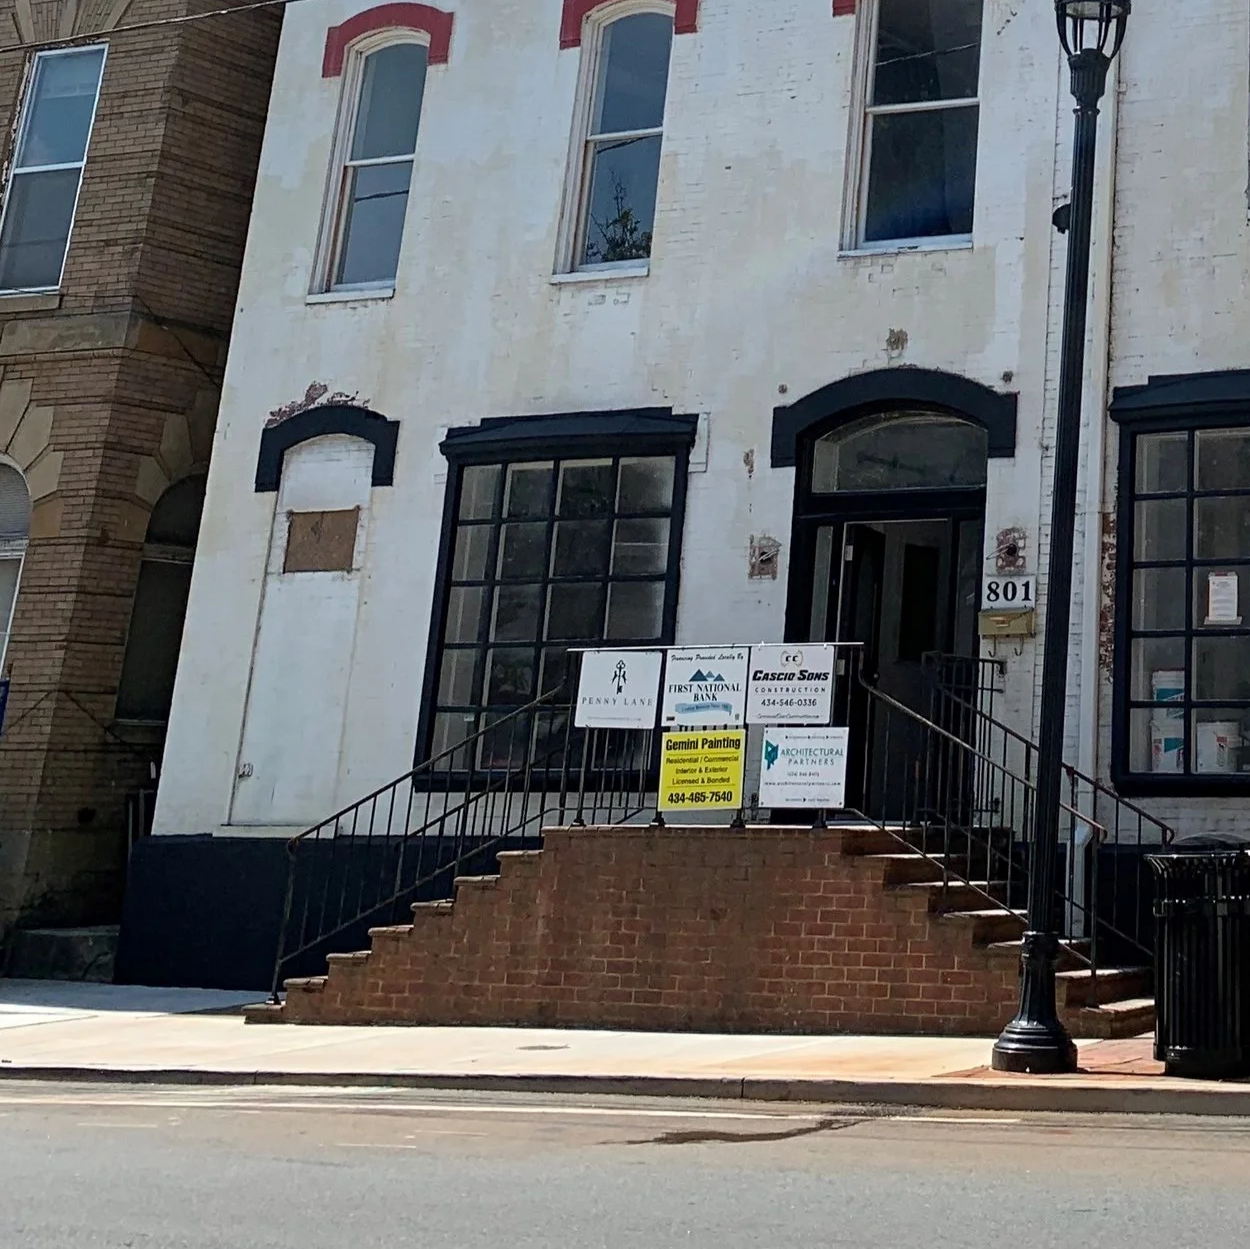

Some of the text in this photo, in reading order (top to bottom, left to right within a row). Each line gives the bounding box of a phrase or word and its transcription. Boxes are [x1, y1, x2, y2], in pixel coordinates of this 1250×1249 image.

[987, 580, 1032, 602] 801
[668, 683, 741, 693] FIRST NATIONAL
[582, 697, 653, 706] PENNY LANE
[693, 693, 718, 702] BANK
[666, 737, 741, 751] Gemini Painting
[780, 748, 844, 757] ARCHITECTURAL
[704, 755, 739, 763] Commercial
[668, 791, 733, 804] 434-465-7540
